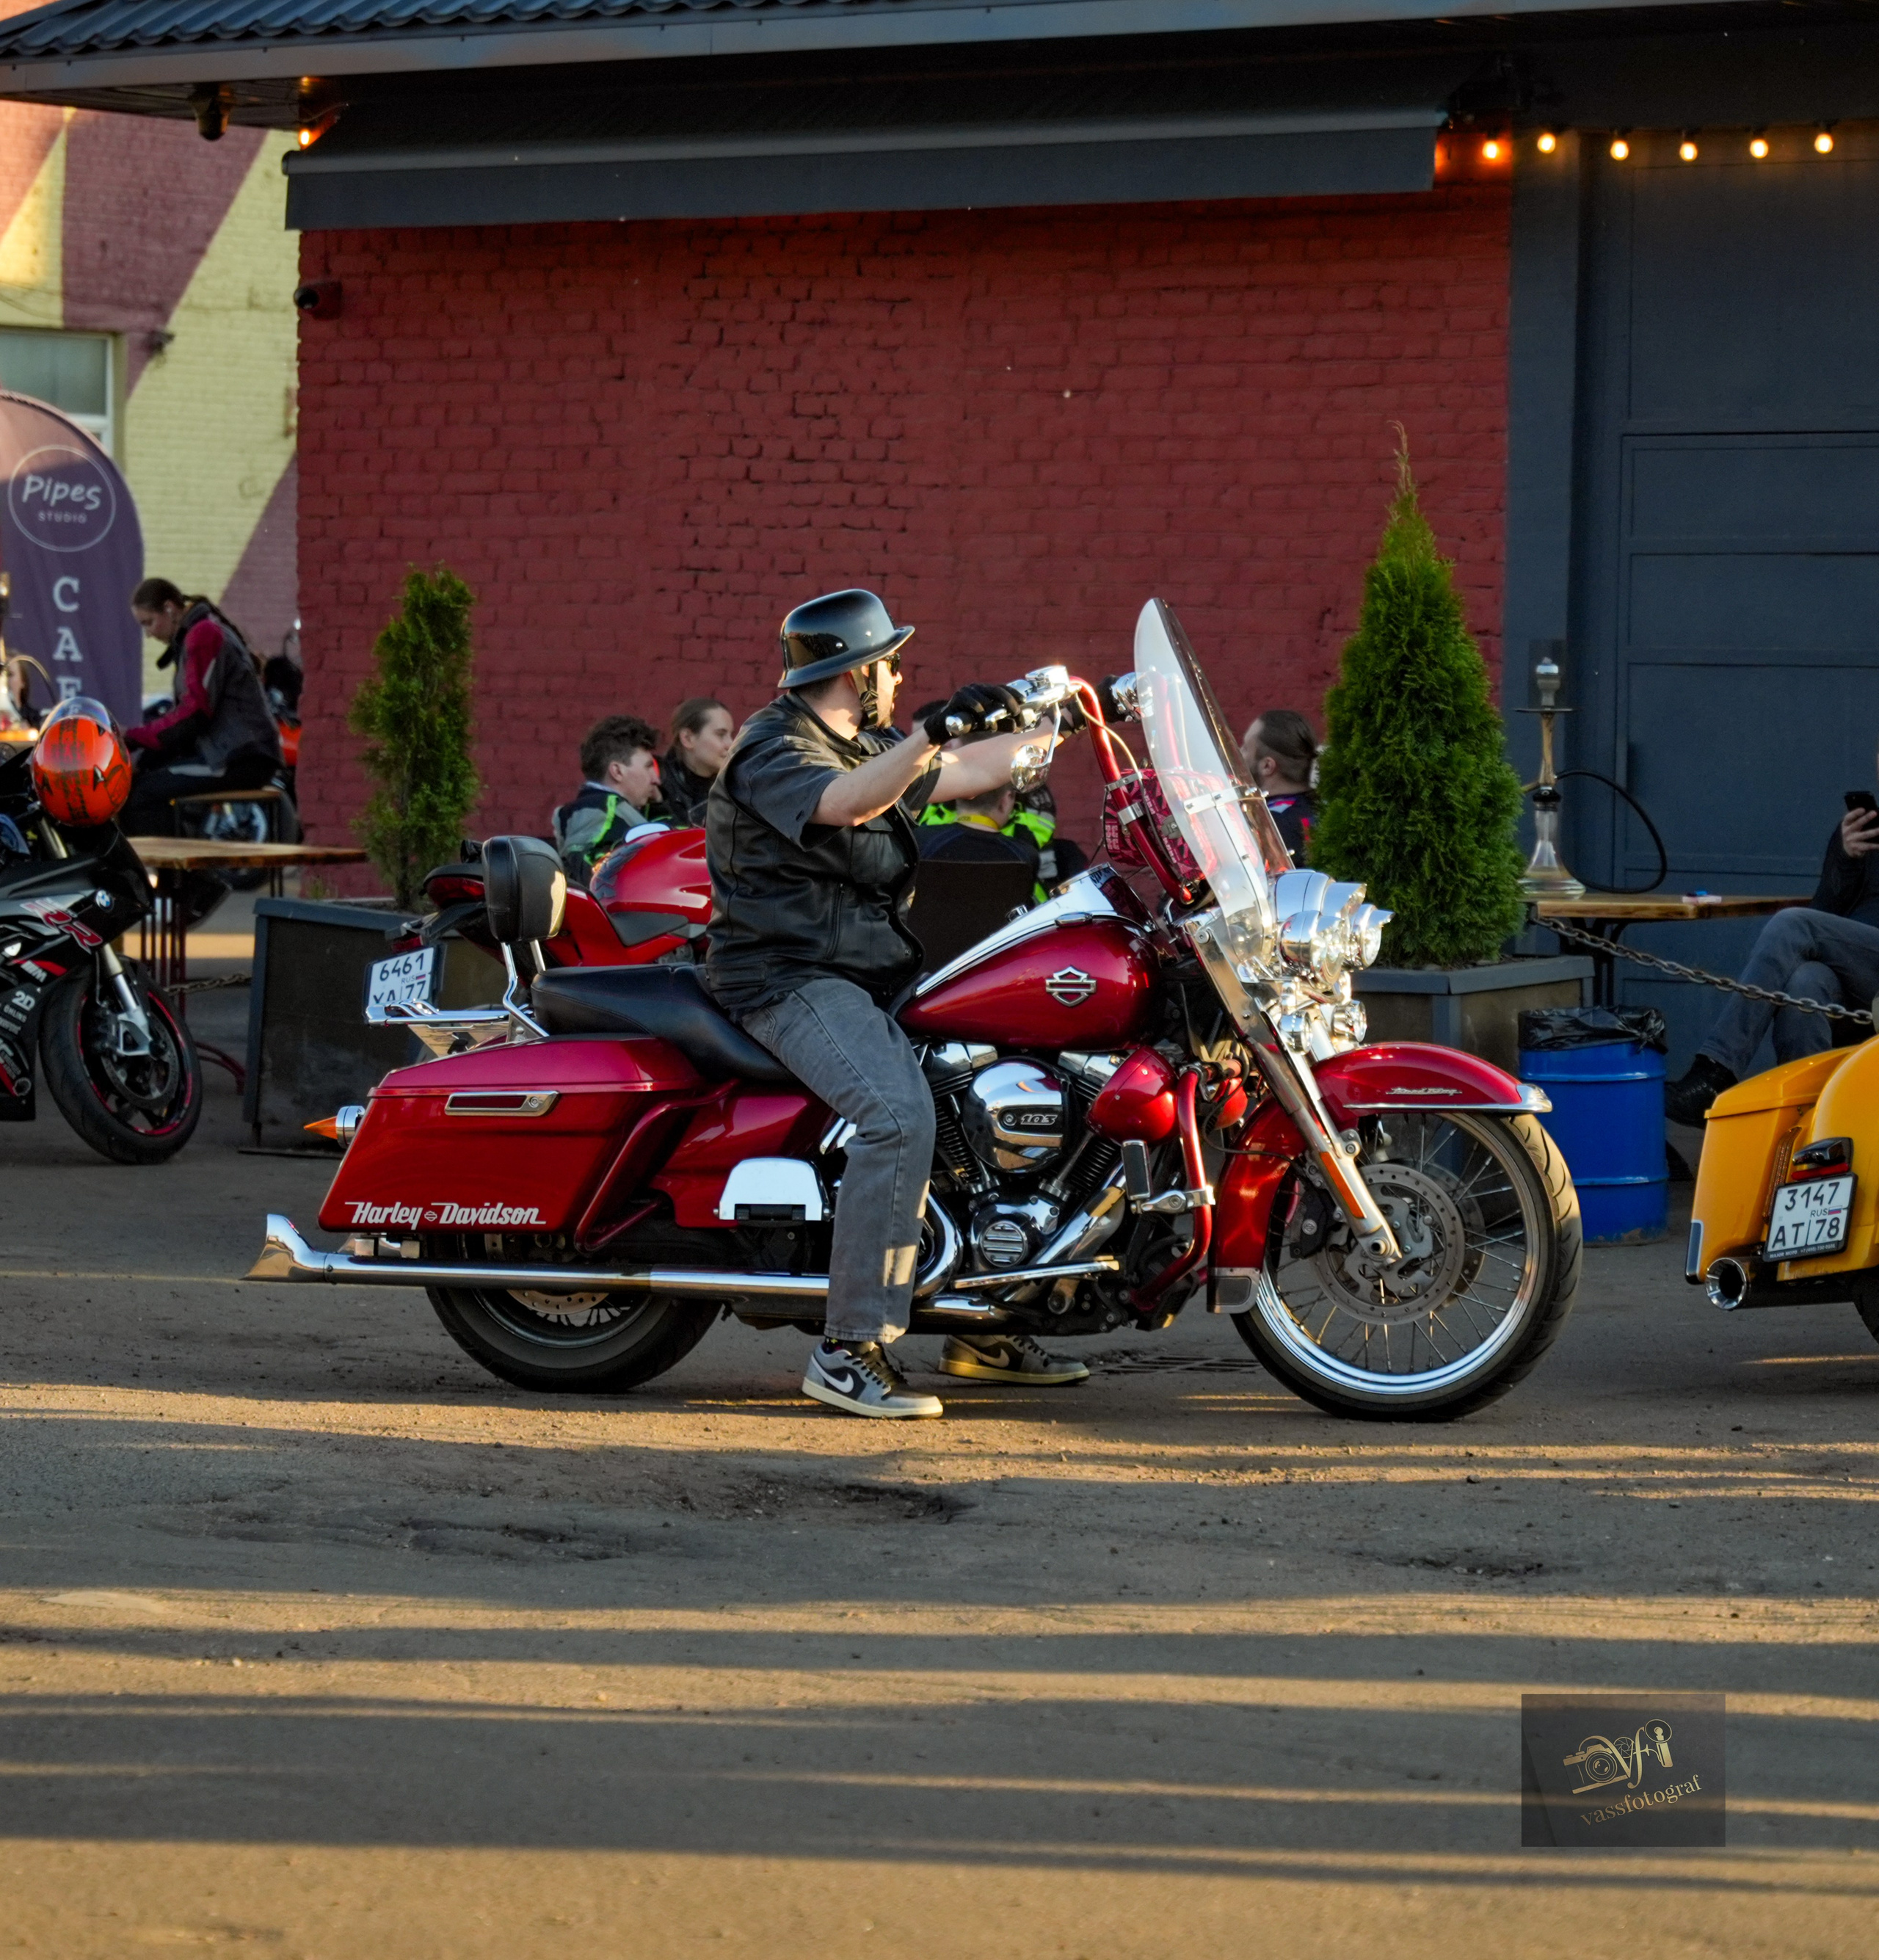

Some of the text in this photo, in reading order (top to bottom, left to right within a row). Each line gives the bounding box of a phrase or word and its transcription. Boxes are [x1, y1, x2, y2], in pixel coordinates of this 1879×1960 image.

[22, 475, 102, 510] Pipes
[379, 953, 425, 981] 6461
[401, 975, 415, 984] RUS
[405, 981, 426, 1000] 77
[12, 990, 35, 1012] 2D
[1021, 1114, 1058, 1125] 103
[1784, 1182, 1840, 1212] 3147
[344, 1202, 547, 1230] Harley Davidson
[1810, 1210, 1828, 1218] RUS
[1814, 1217, 1840, 1242] 78
